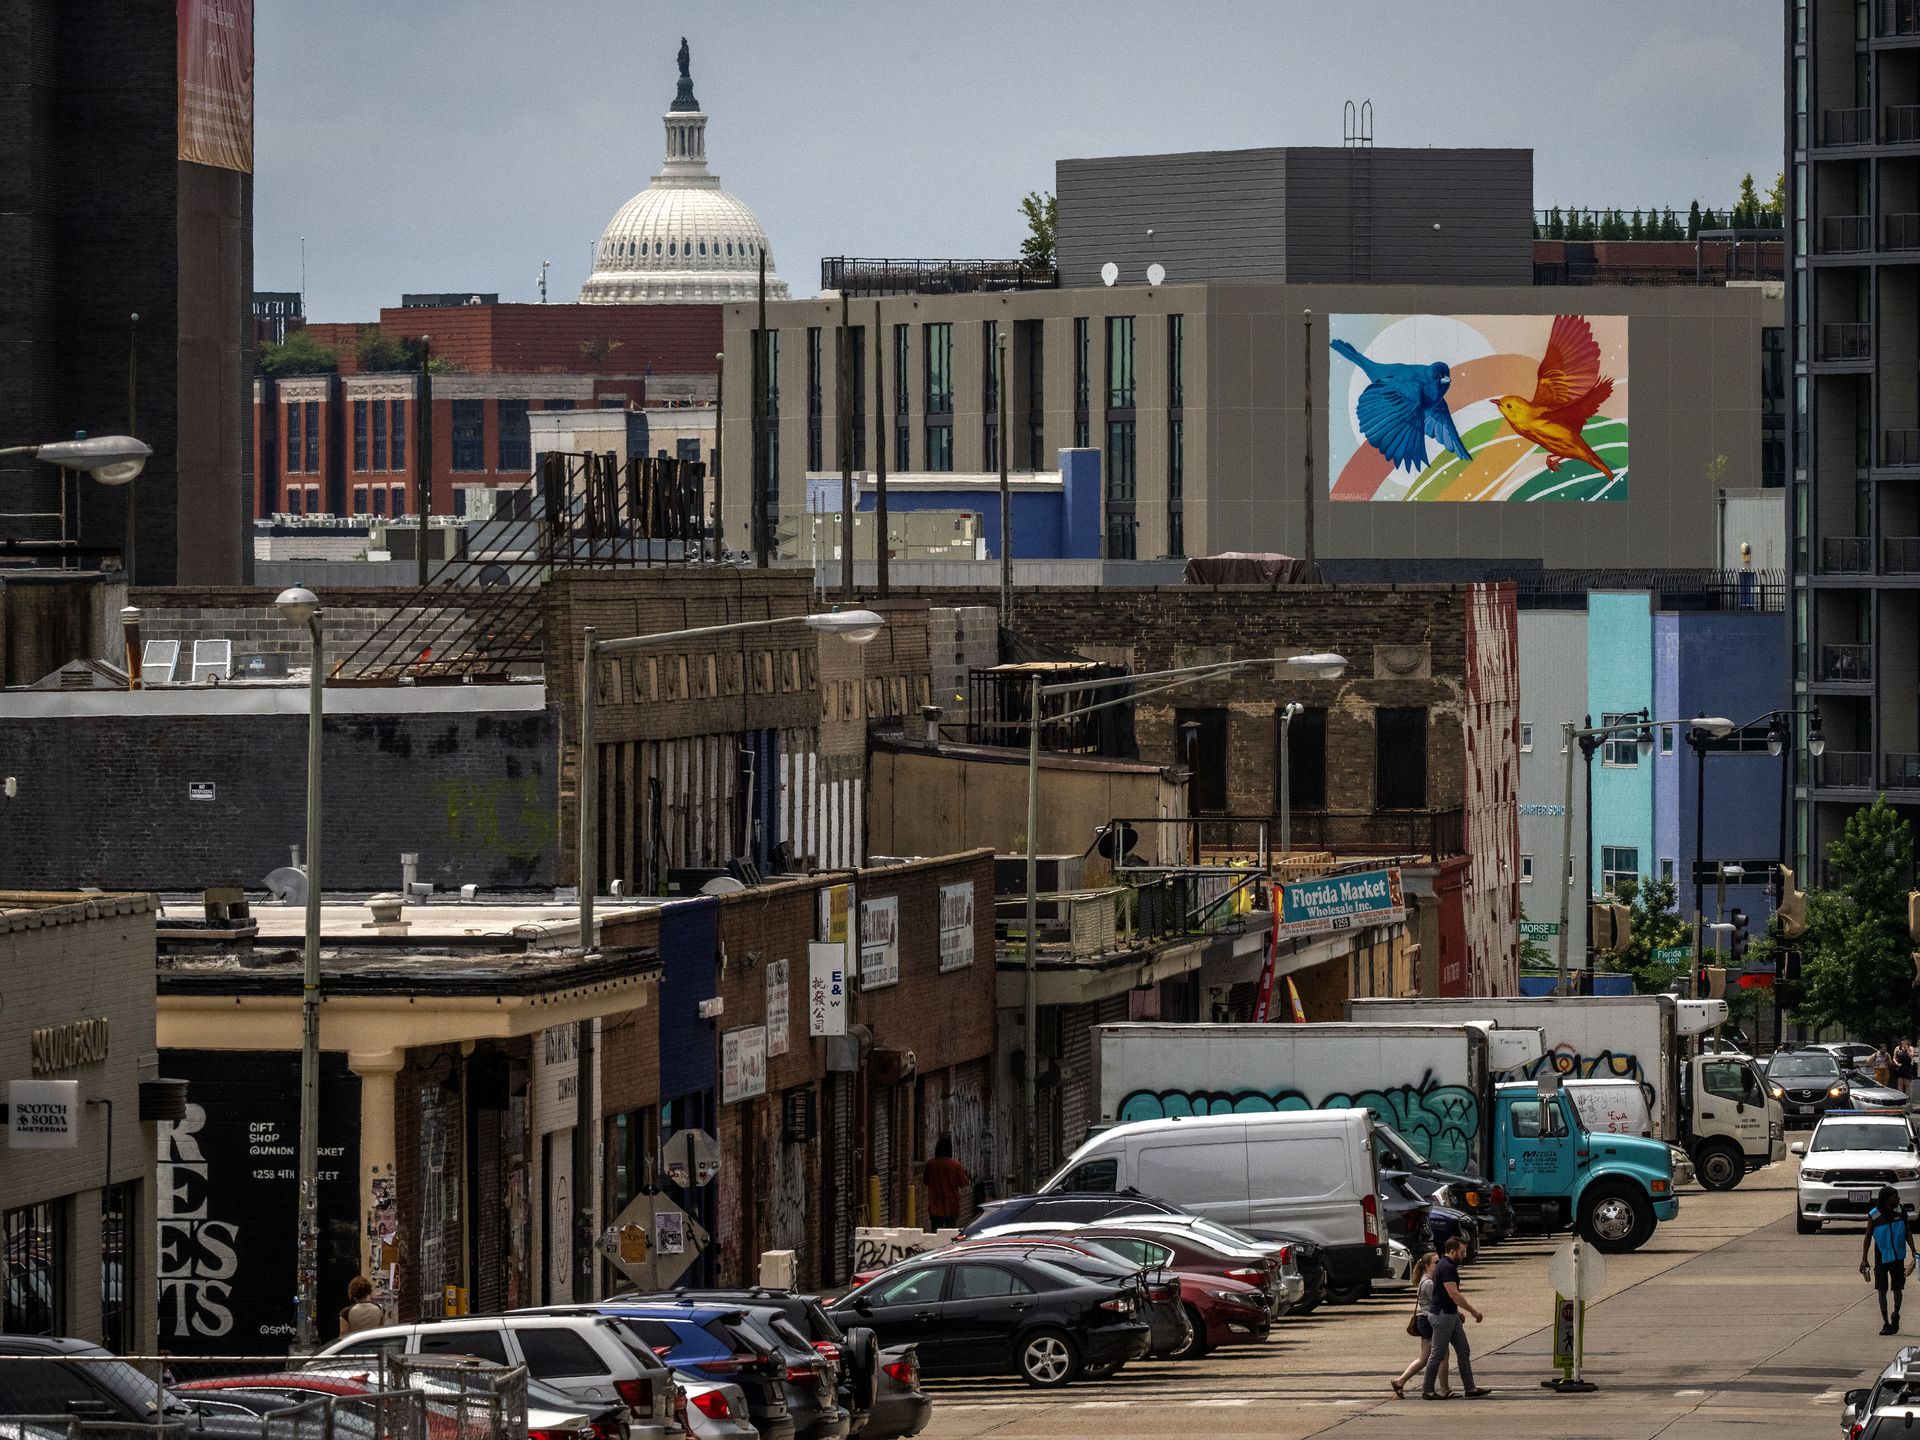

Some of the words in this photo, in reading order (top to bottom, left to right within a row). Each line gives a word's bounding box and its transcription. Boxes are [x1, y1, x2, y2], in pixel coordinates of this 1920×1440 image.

[1549, 804, 1565, 816] SCHO
[1291, 885, 1338, 908] Florida
[1339, 879, 1386, 901] Market
[1307, 902, 1354, 918] Wholesale
[1355, 901, 1372, 912] Inc.
[1521, 924, 1549, 933] MORSE
[1657, 949, 1682, 959] Florida
[832, 971, 842, 982] E
[831, 984, 842, 995] &
[17, 1104, 67, 1114] SCOTCH
[32, 1115, 67, 1125] SODA
[249, 1122, 275, 1132] GIFT
[249, 1133, 280, 1143] SHOP
[249, 1146, 294, 1155] @UNION
[317, 1147, 345, 1156] RKET
[252, 1169, 275, 1179] 1258
[278, 1169, 295, 1179] 4TH
